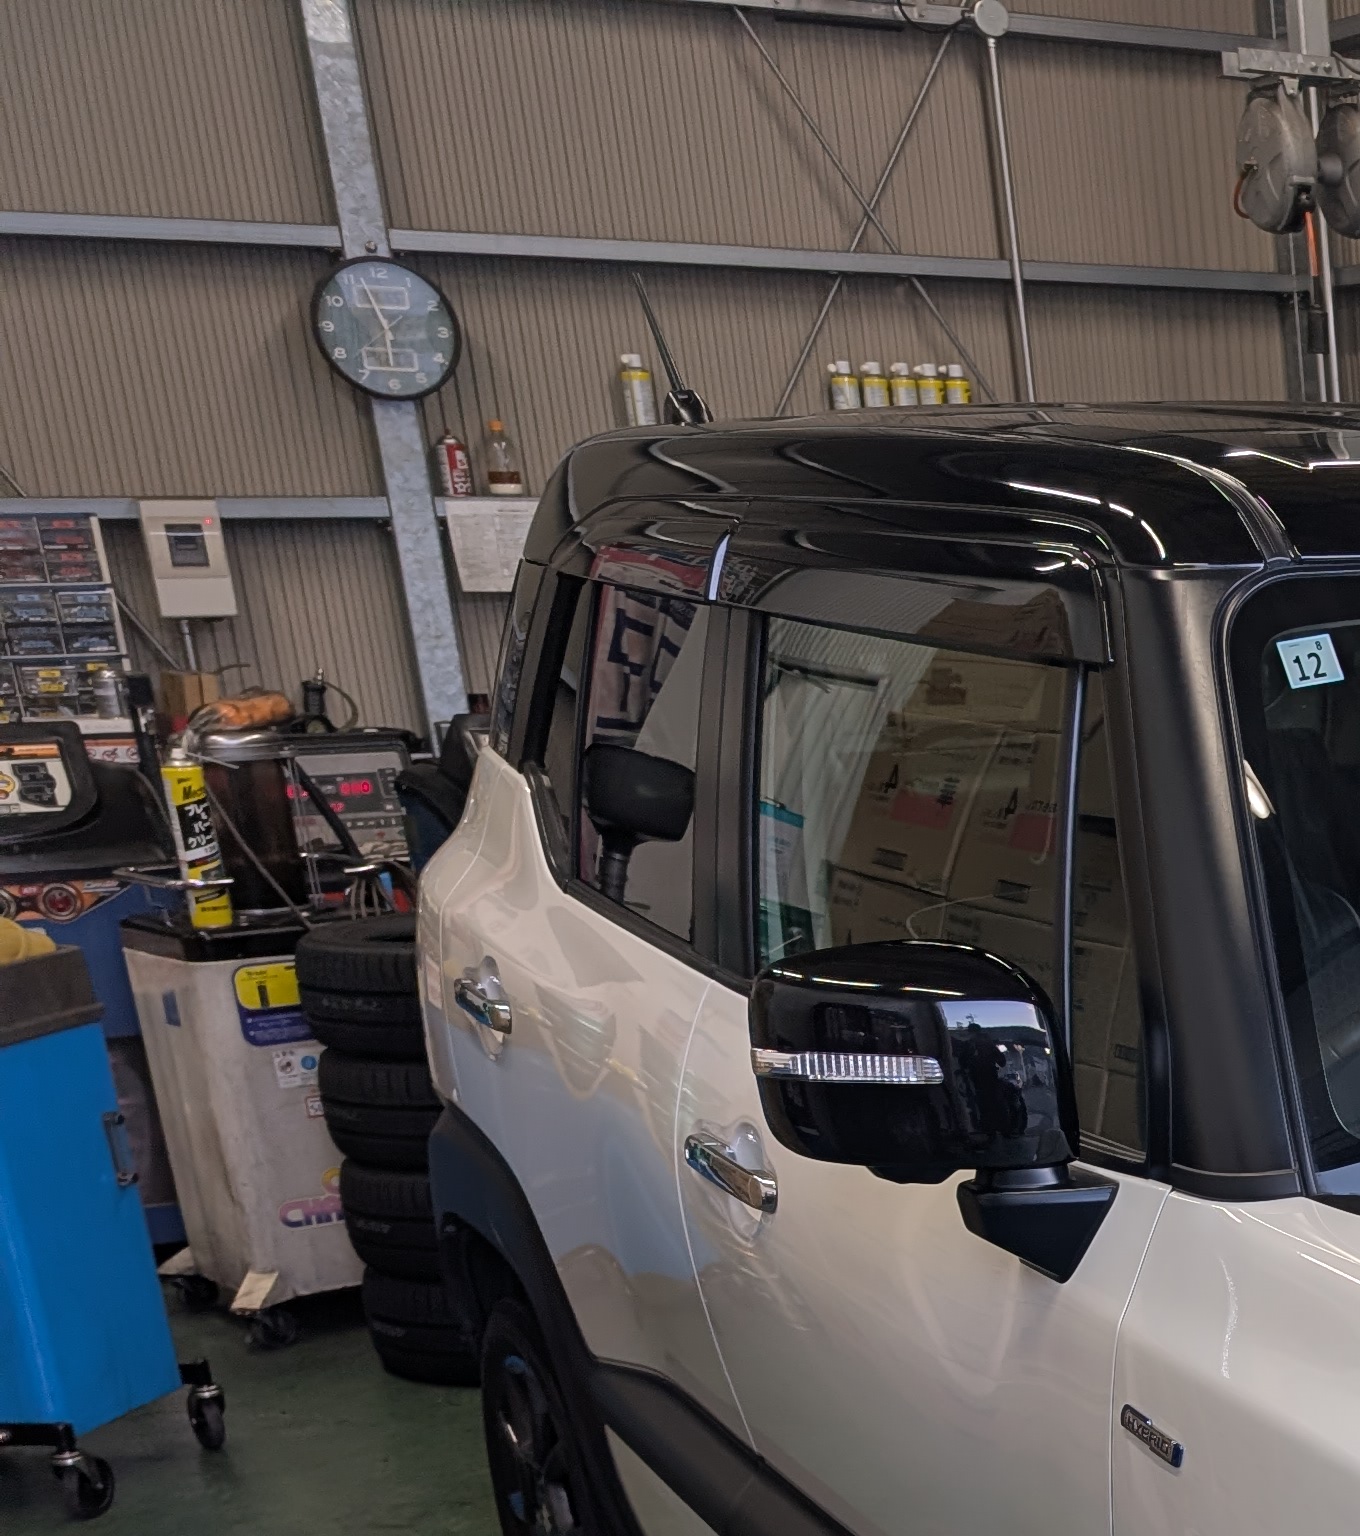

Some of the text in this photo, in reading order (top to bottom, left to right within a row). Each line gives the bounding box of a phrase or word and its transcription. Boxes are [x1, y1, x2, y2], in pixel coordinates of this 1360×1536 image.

[370, 267, 388, 279] 12
[343, 274, 355, 285] 11
[405, 277, 412, 288] 1
[326, 295, 343, 307] 10
[427, 300, 439, 312] 2
[321, 320, 335, 332] 9
[437, 326, 449, 338] 3
[333, 347, 347, 359] 8
[433, 352, 445, 364] 4
[358, 369, 370, 383] 7
[415, 372, 427, 384] 5
[388, 378, 401, 390] 6
[1315, 641, 1322, 650] 8
[1293, 652, 1327, 681] 12
